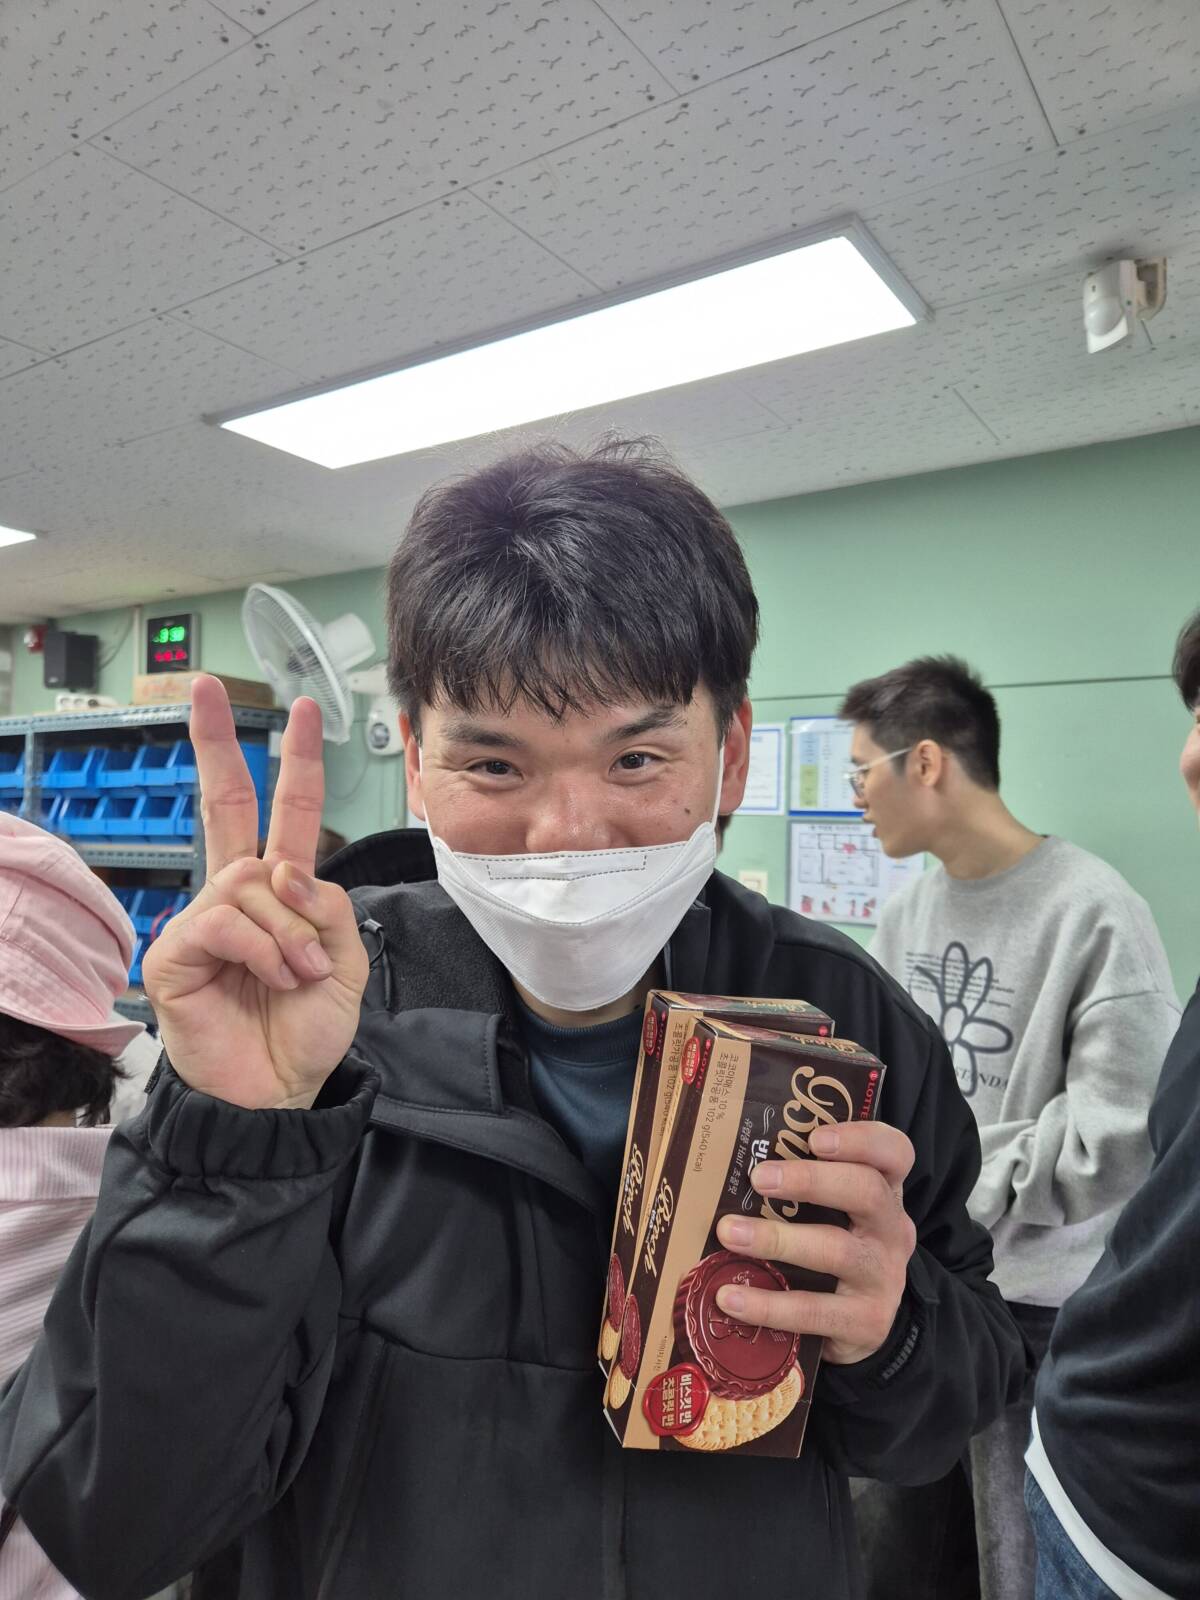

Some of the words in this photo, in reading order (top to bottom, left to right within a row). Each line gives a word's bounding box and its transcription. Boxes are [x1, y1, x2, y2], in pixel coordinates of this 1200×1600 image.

[709, 1053, 728, 1103] 초콜릿가공품
[721, 1053, 739, 1095] 코코아매스
[706, 1108, 716, 1124] 102
[719, 1100, 728, 1110] 10
[860, 1082, 877, 1120] LOTTE
[734, 1145, 746, 1168] Half
[728, 1167, 742, 1196] 초콜릿
[644, 1178, 674, 1278] Binch
[662, 1377, 675, 1413] 초콜릿
[680, 1373, 692, 1410] 비스킷
[662, 1414, 675, 1427] 반
[679, 1410, 692, 1424] 반
